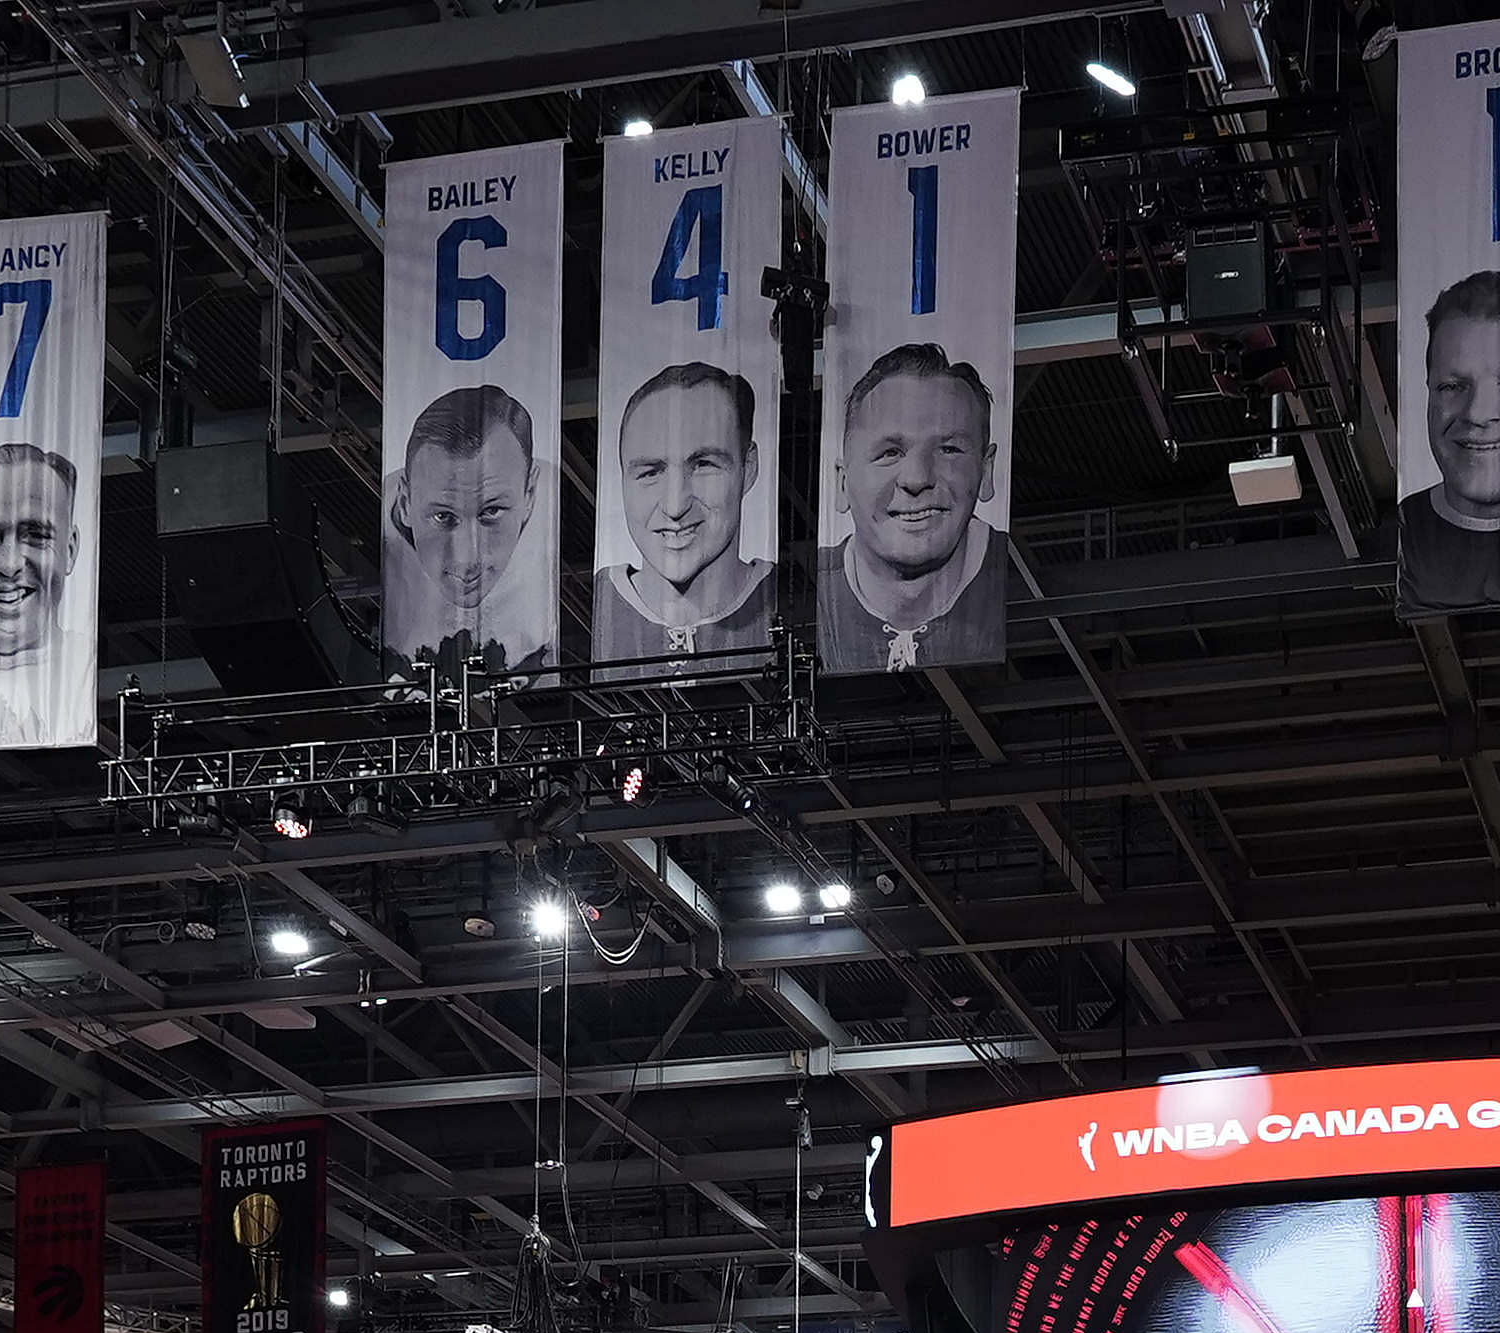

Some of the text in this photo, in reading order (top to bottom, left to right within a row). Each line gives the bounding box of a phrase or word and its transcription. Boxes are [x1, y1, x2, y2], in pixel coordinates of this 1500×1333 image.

[876, 123, 972, 160] BOWER
[654, 148, 730, 184] KELLY
[427, 175, 517, 213] BAILEY
[651, 184, 729, 331] 4
[908, 164, 938, 315] 1
[435, 214, 508, 361] 6
[1112, 1118, 1246, 1160] WNBA
[1256, 1101, 1459, 1145] CANADA
[220, 1139, 306, 1165] TORONTO
[219, 1162, 307, 1189] RAPTORS
[236, 1311, 289, 1333] 2019
